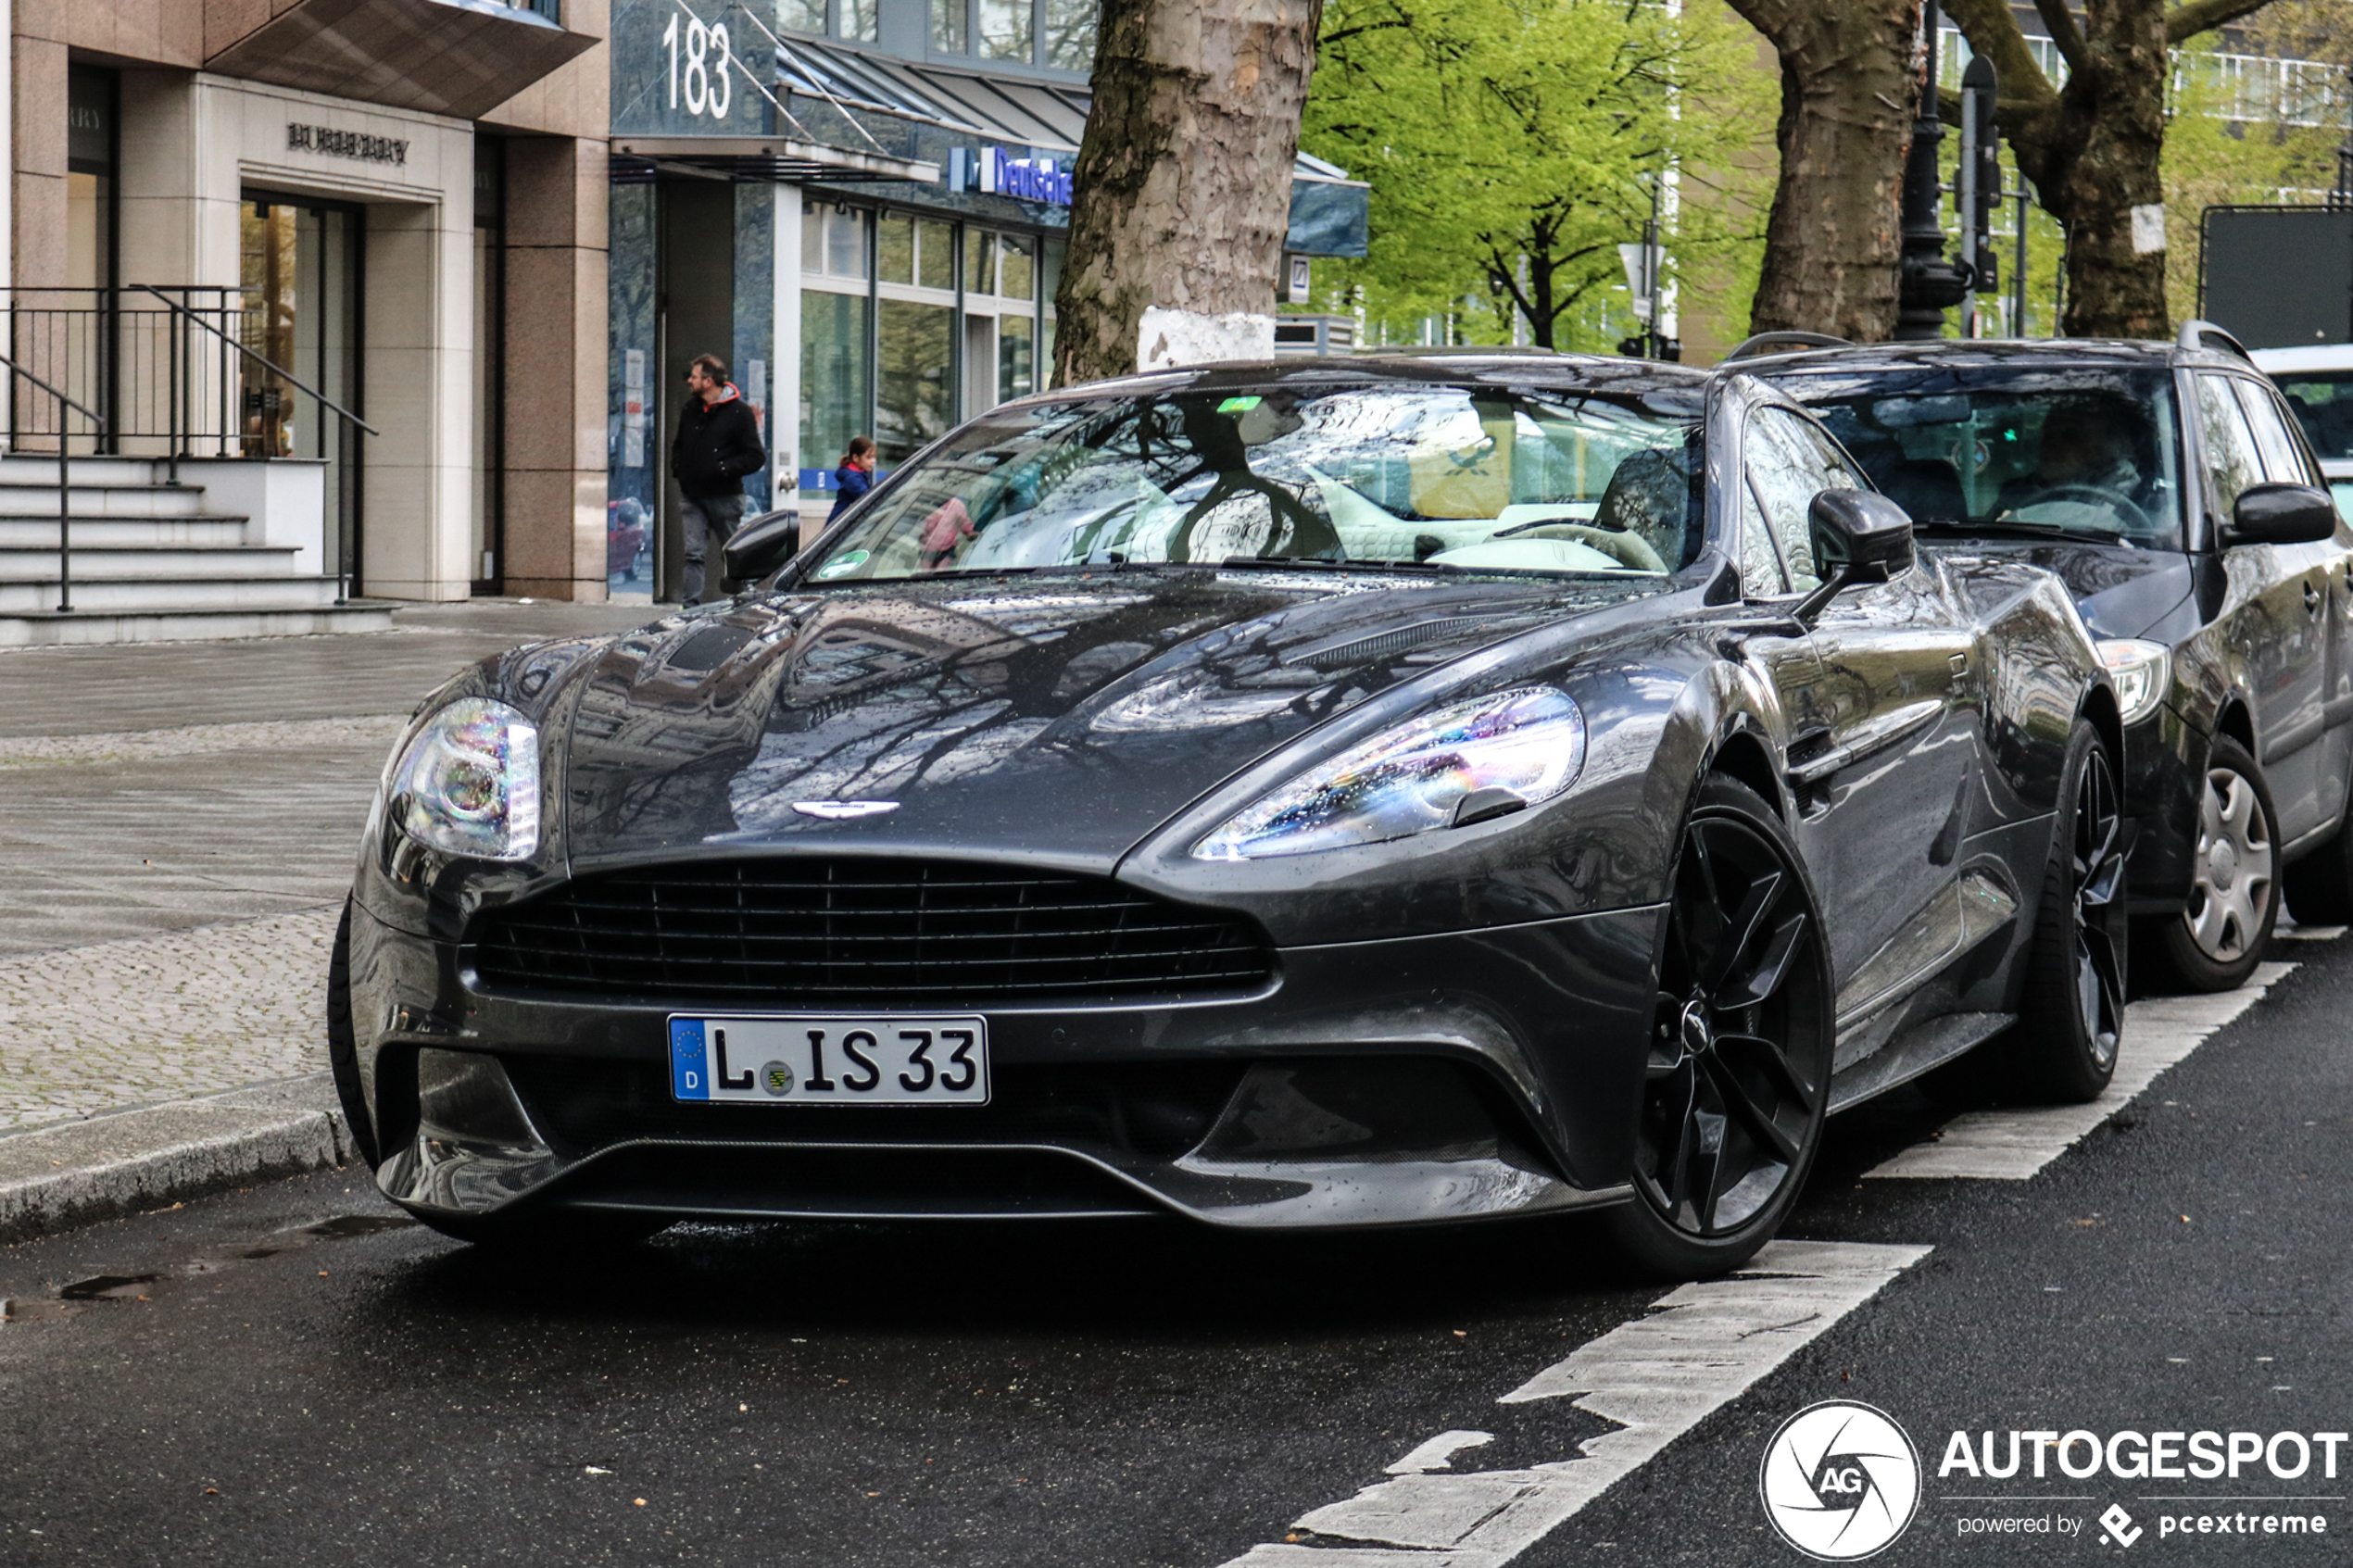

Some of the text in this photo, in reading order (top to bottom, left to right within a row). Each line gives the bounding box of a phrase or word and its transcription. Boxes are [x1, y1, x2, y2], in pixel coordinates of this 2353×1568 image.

[663, 12, 731, 119] 183
[288, 122, 410, 165] BURBERRY
[996, 147, 1074, 206] Deutsche
[686, 1071, 698, 1089] D
[714, 1028, 755, 1090] L
[804, 1029, 881, 1092] IS
